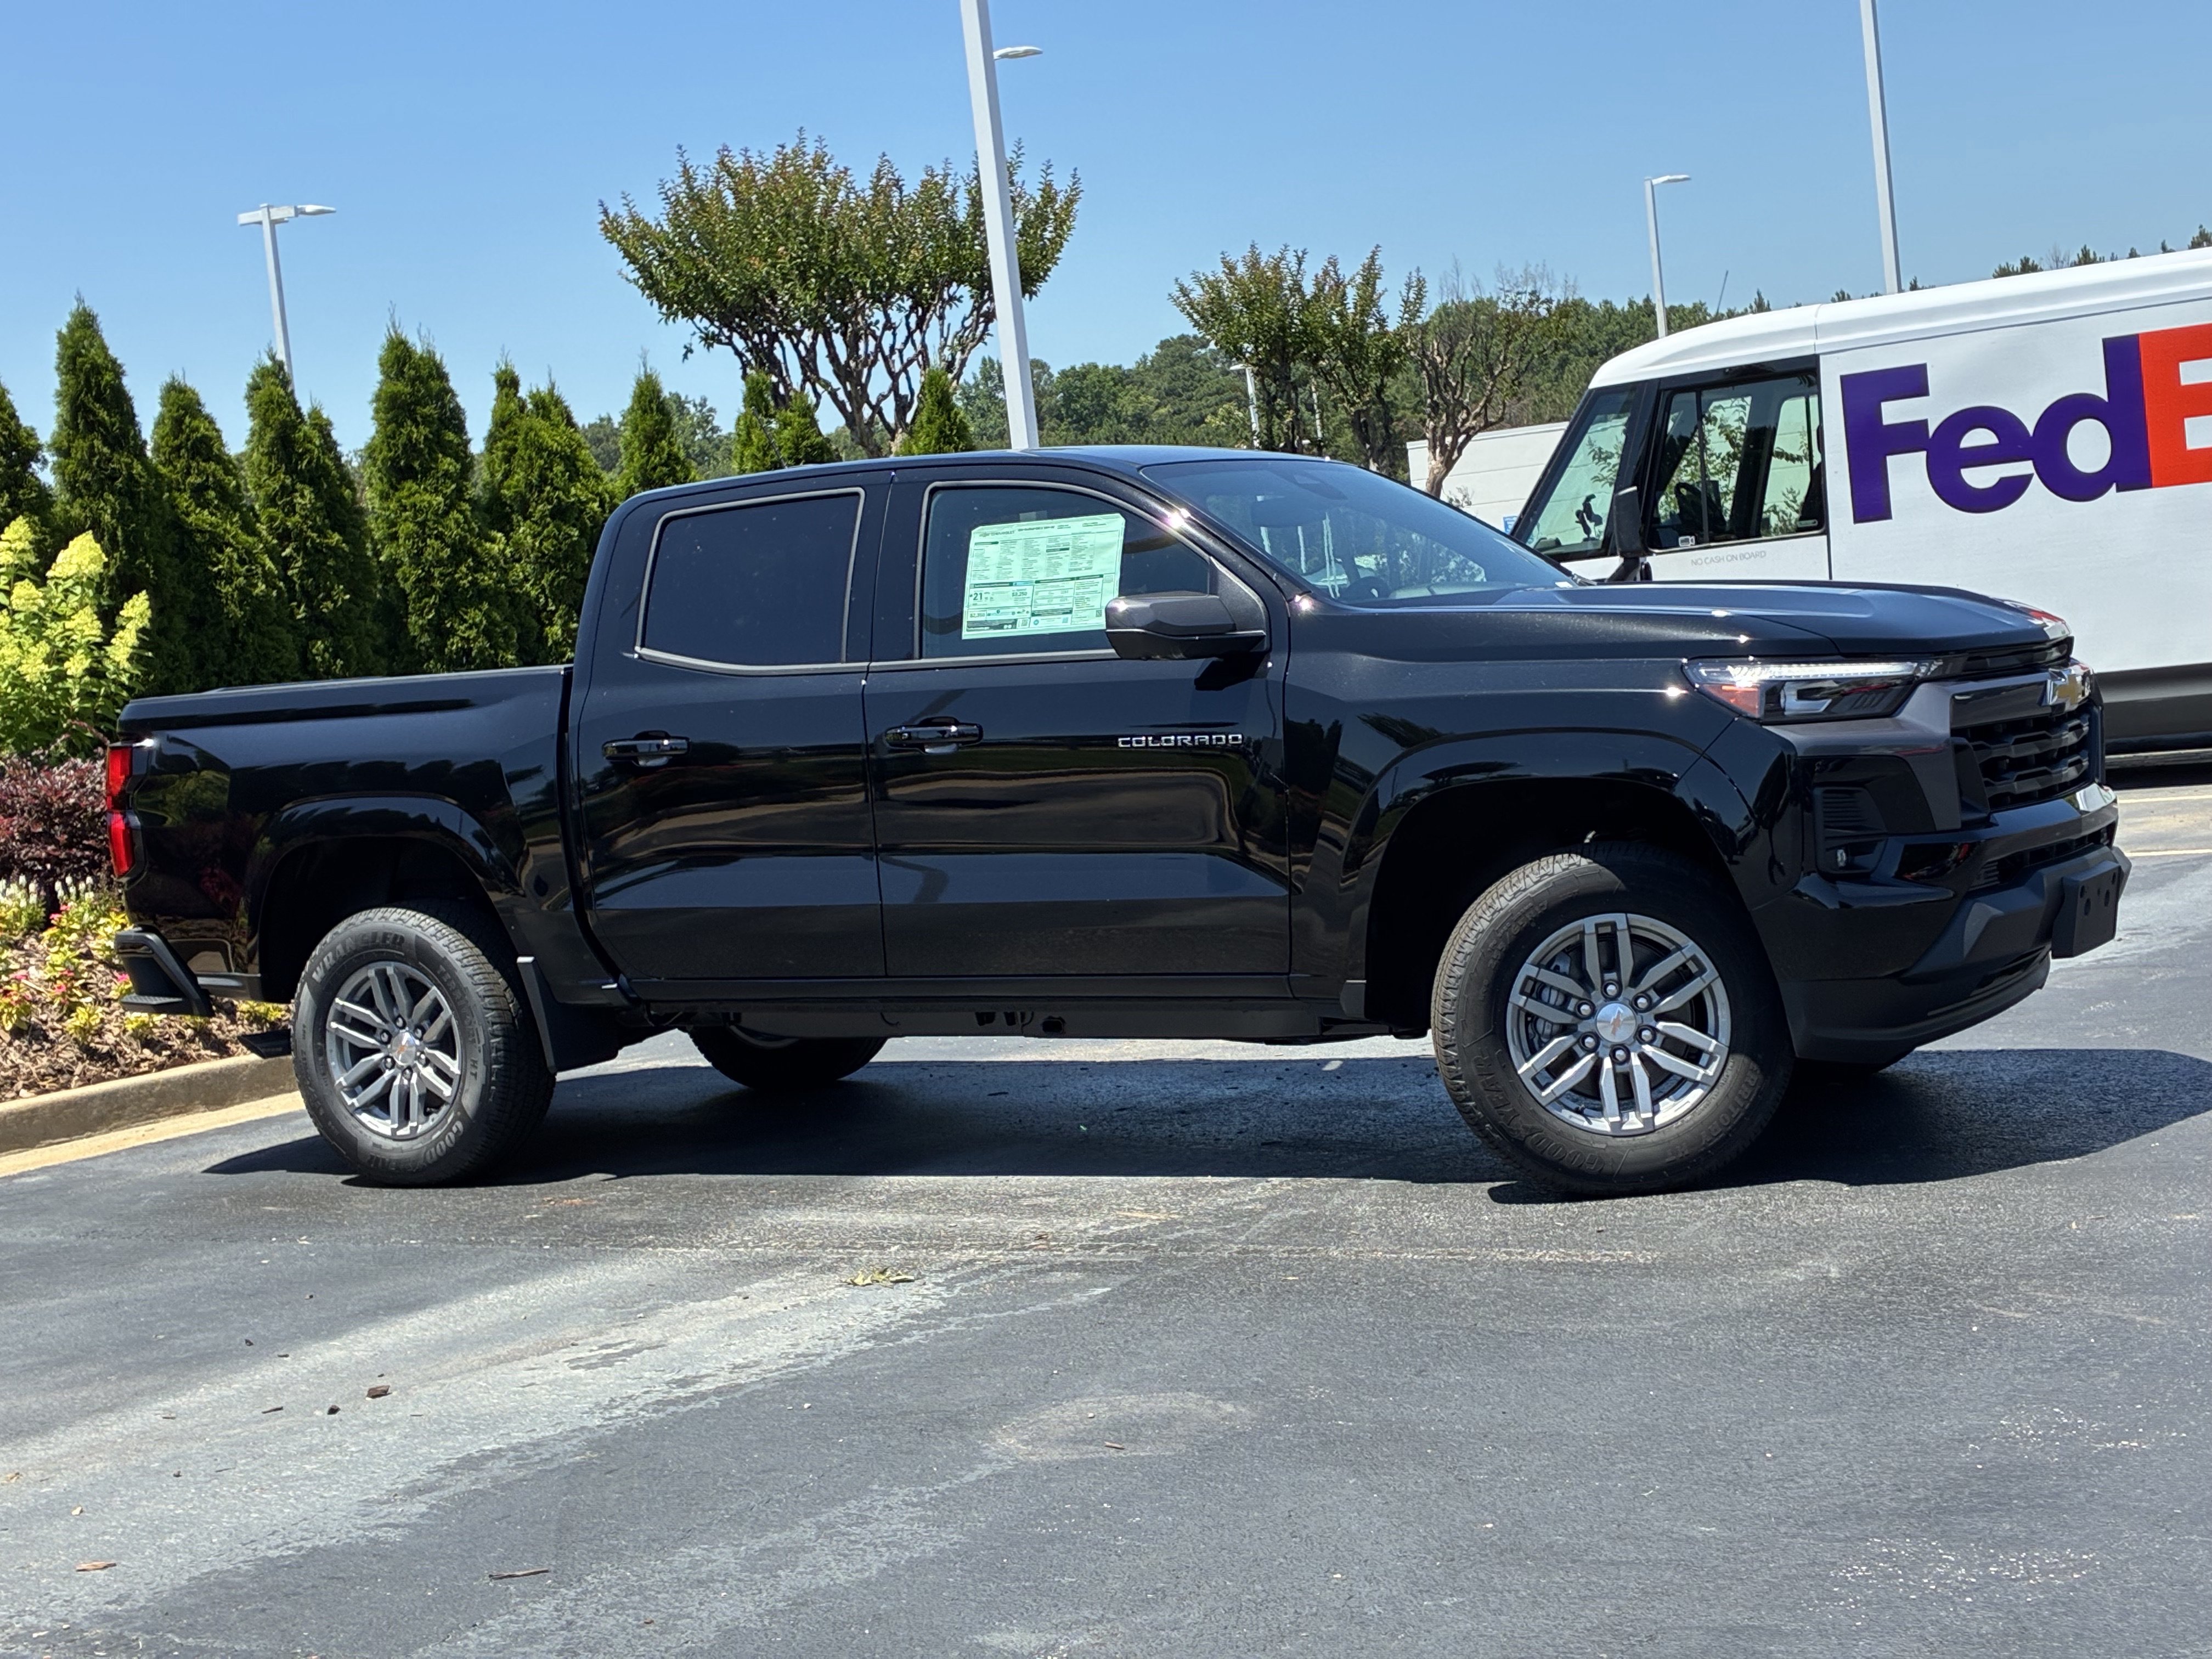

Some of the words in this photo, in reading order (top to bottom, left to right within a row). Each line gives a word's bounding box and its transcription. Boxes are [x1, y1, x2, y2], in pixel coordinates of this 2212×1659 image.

[1704, 555, 1724, 565] CASH
[1726, 554, 1738, 562] ON
[1739, 550, 1767, 560] BOARD
[973, 592, 983, 601] 21
[1118, 733, 1243, 748] COLORADO
[311, 930, 405, 984] WRANGLER
